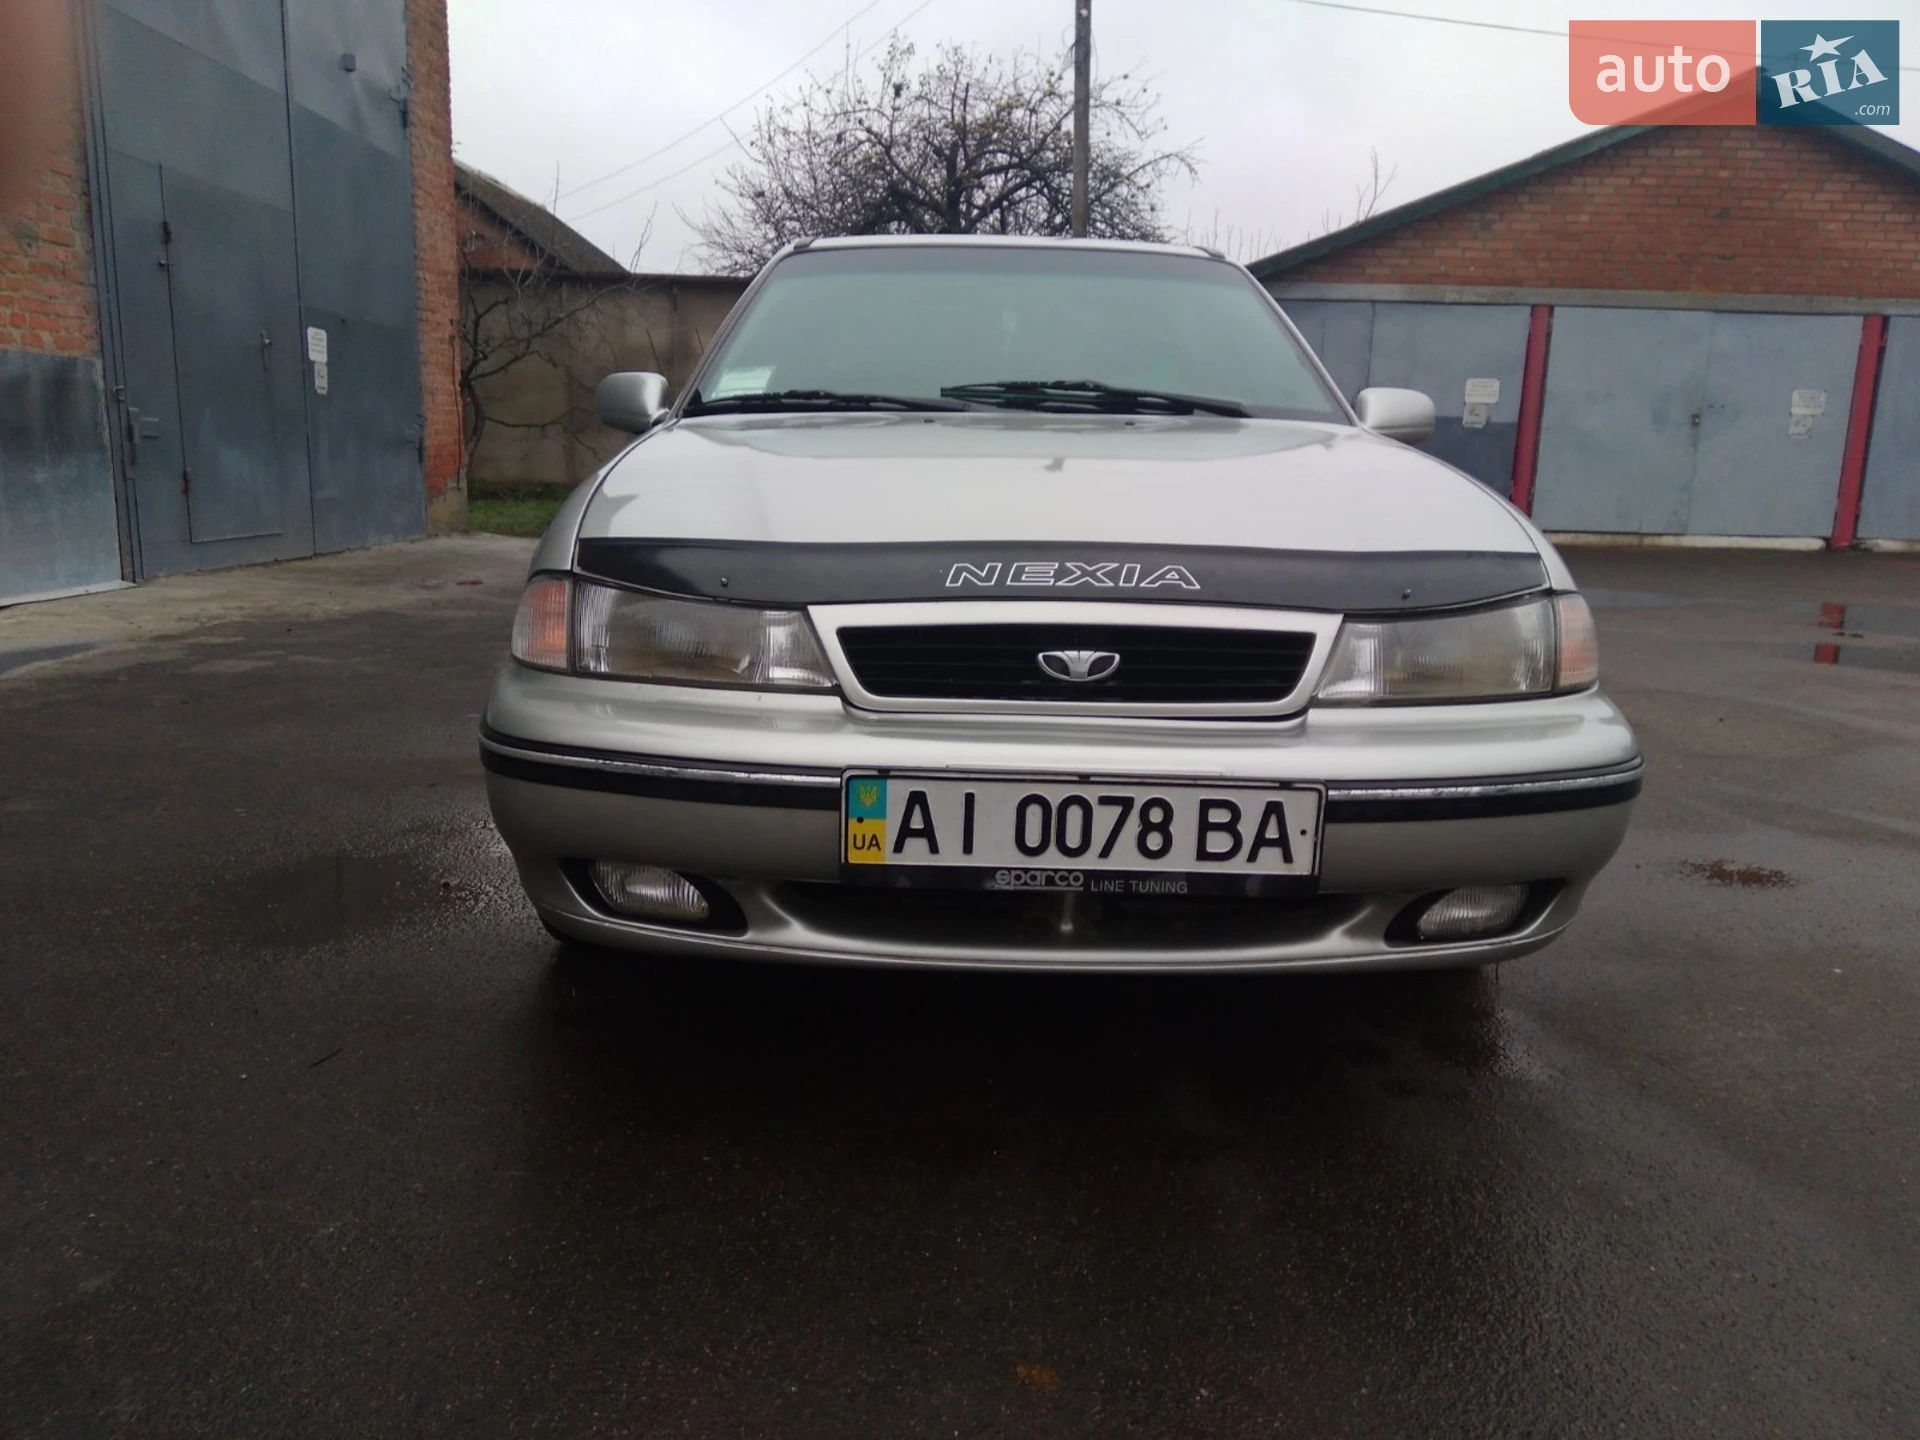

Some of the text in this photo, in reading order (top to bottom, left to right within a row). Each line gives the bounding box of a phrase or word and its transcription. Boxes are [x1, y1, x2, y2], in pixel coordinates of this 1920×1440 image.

[945, 562, 1201, 590] NEXIA
[1014, 793, 1175, 861] 0078
[1195, 798, 1295, 864] BA
[852, 833, 882, 852] UA
[1090, 880, 1124, 893] LINE
[1129, 880, 1188, 895] TUNING
